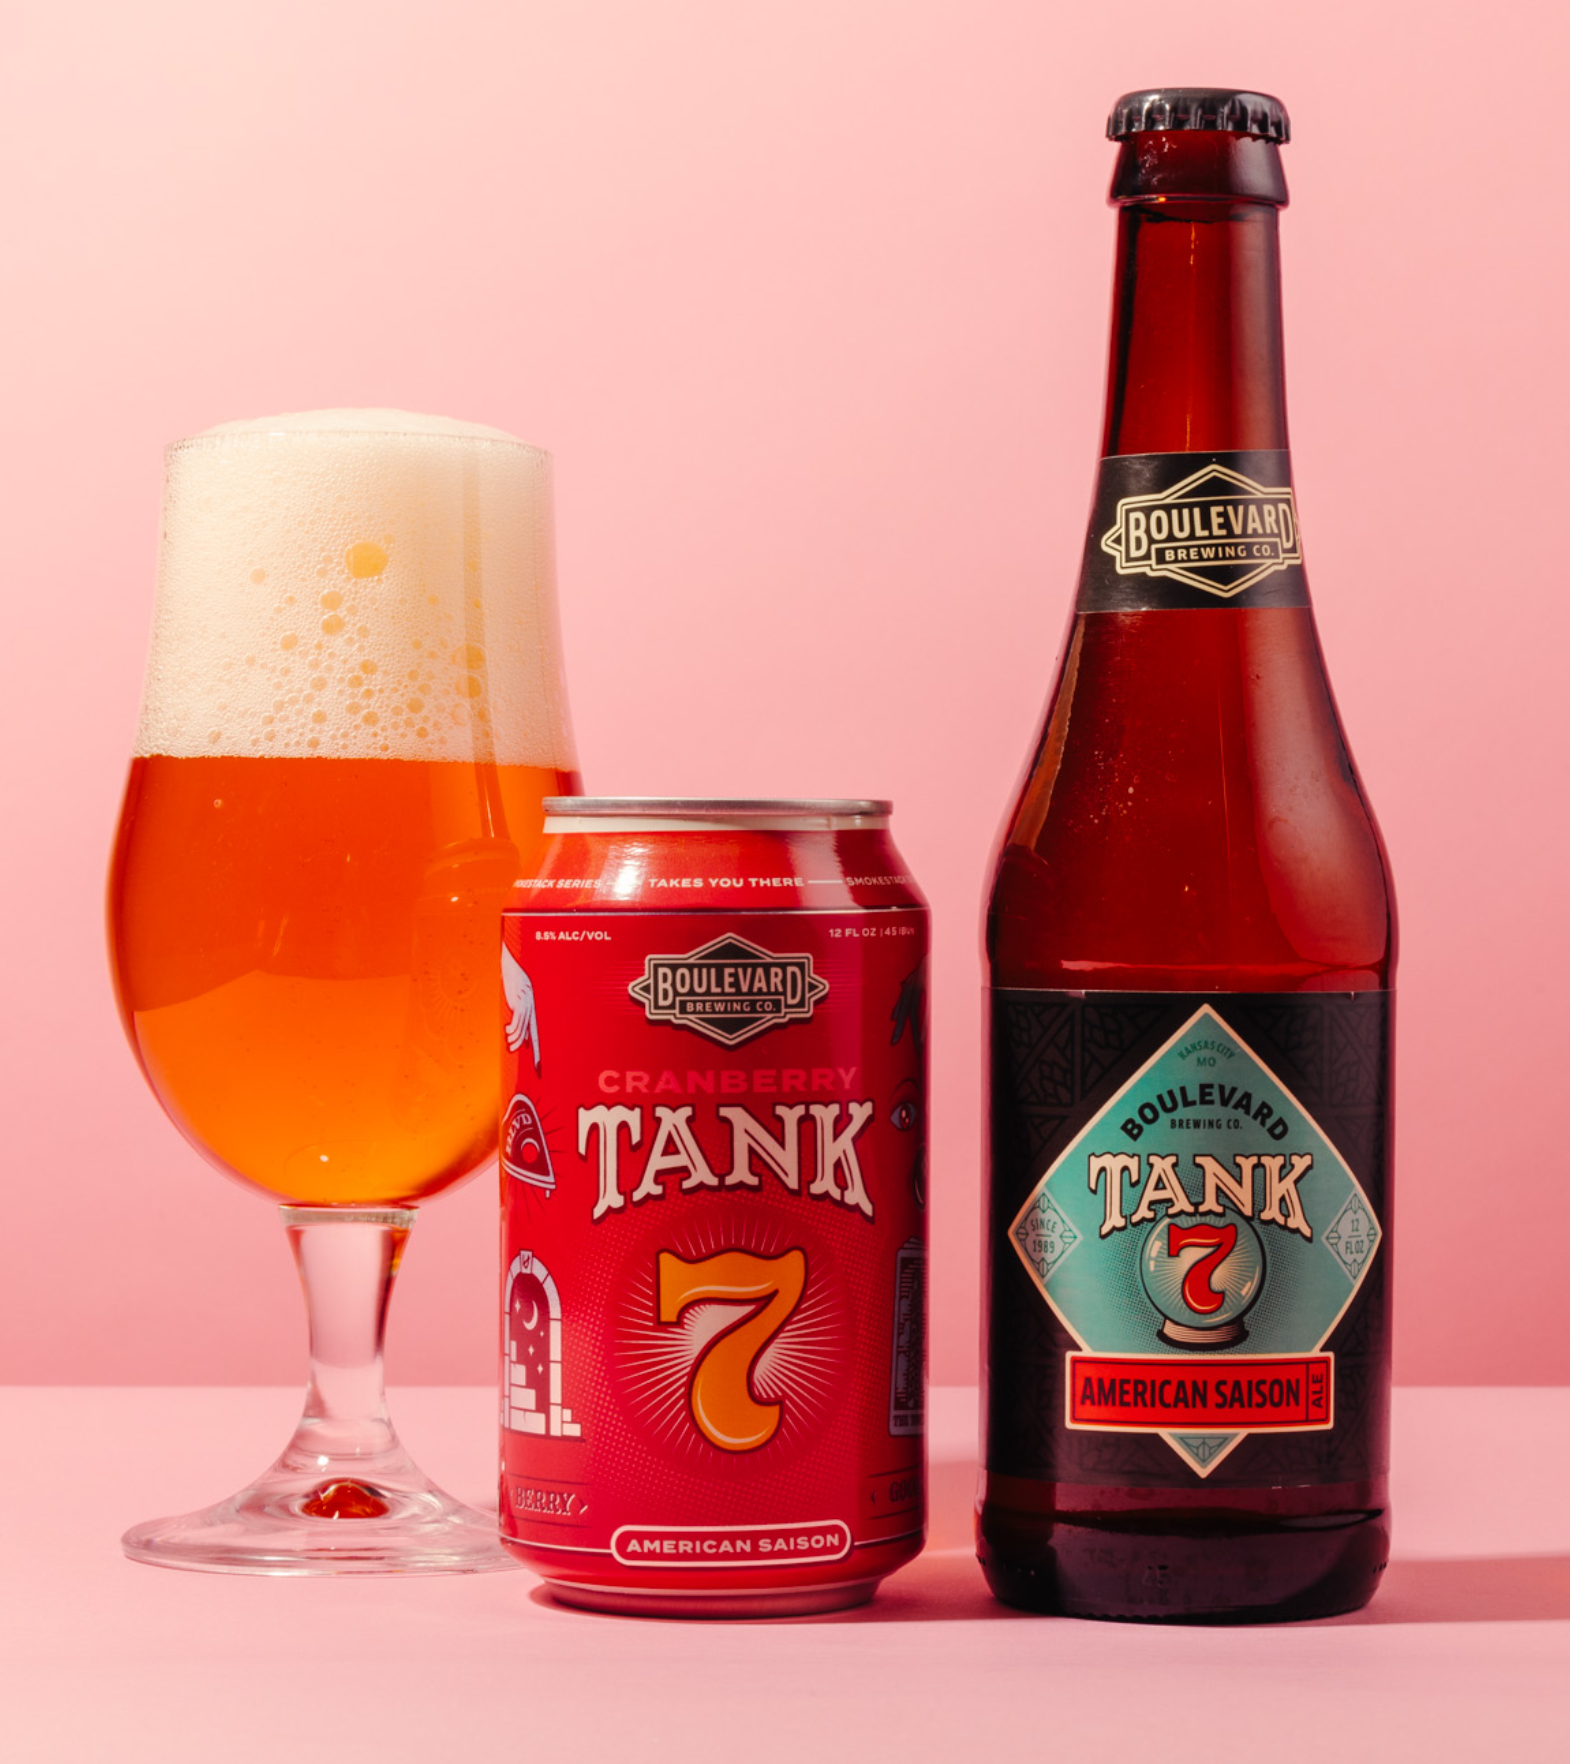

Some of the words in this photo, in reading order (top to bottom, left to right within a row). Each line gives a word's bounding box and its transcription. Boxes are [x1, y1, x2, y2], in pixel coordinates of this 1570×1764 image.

[1129, 503, 1294, 558] BOULEVARD
[1165, 544, 1247, 561] BREWING
[1252, 544, 1275, 557] CO.
[556, 879, 602, 888] SERIES
[649, 878, 703, 888] TAKES
[708, 878, 744, 887] YOU
[747, 877, 804, 887] THERE
[558, 930, 612, 940] ALC/VOL
[829, 928, 842, 937] 12
[845, 928, 859, 937] FL
[862, 927, 876, 936] OZ
[657, 966, 803, 1007] BOULEVARD
[686, 1001, 751, 1012] BREWING
[756, 1001, 776, 1011] CO.
[1177, 1040, 1216, 1060] KANSAS
[1216, 1043, 1236, 1059] CITY
[1196, 1056, 1216, 1067] MO
[598, 1067, 858, 1094] CRANBERRY
[1119, 1083, 1289, 1142] BOULEVARD
[1170, 1118, 1222, 1129] BREWING
[1226, 1119, 1243, 1129] CO.
[577, 1100, 874, 1222] TANK
[1088, 1152, 1314, 1242] TANK
[1030, 1218, 1057, 1233] SINCE
[1351, 1218, 1360, 1232] 12
[1033, 1240, 1055, 1253] 1989
[1168, 1223, 1238, 1314] 7
[656, 1247, 808, 1453] 7
[1080, 1377, 1208, 1410] AMERICAN
[1214, 1379, 1301, 1409] SAISON
[1311, 1372, 1324, 1410] ALE
[515, 1486, 575, 1516] BERRY
[626, 1538, 752, 1554] AMERICAN
[758, 1534, 840, 1551] SAISON
